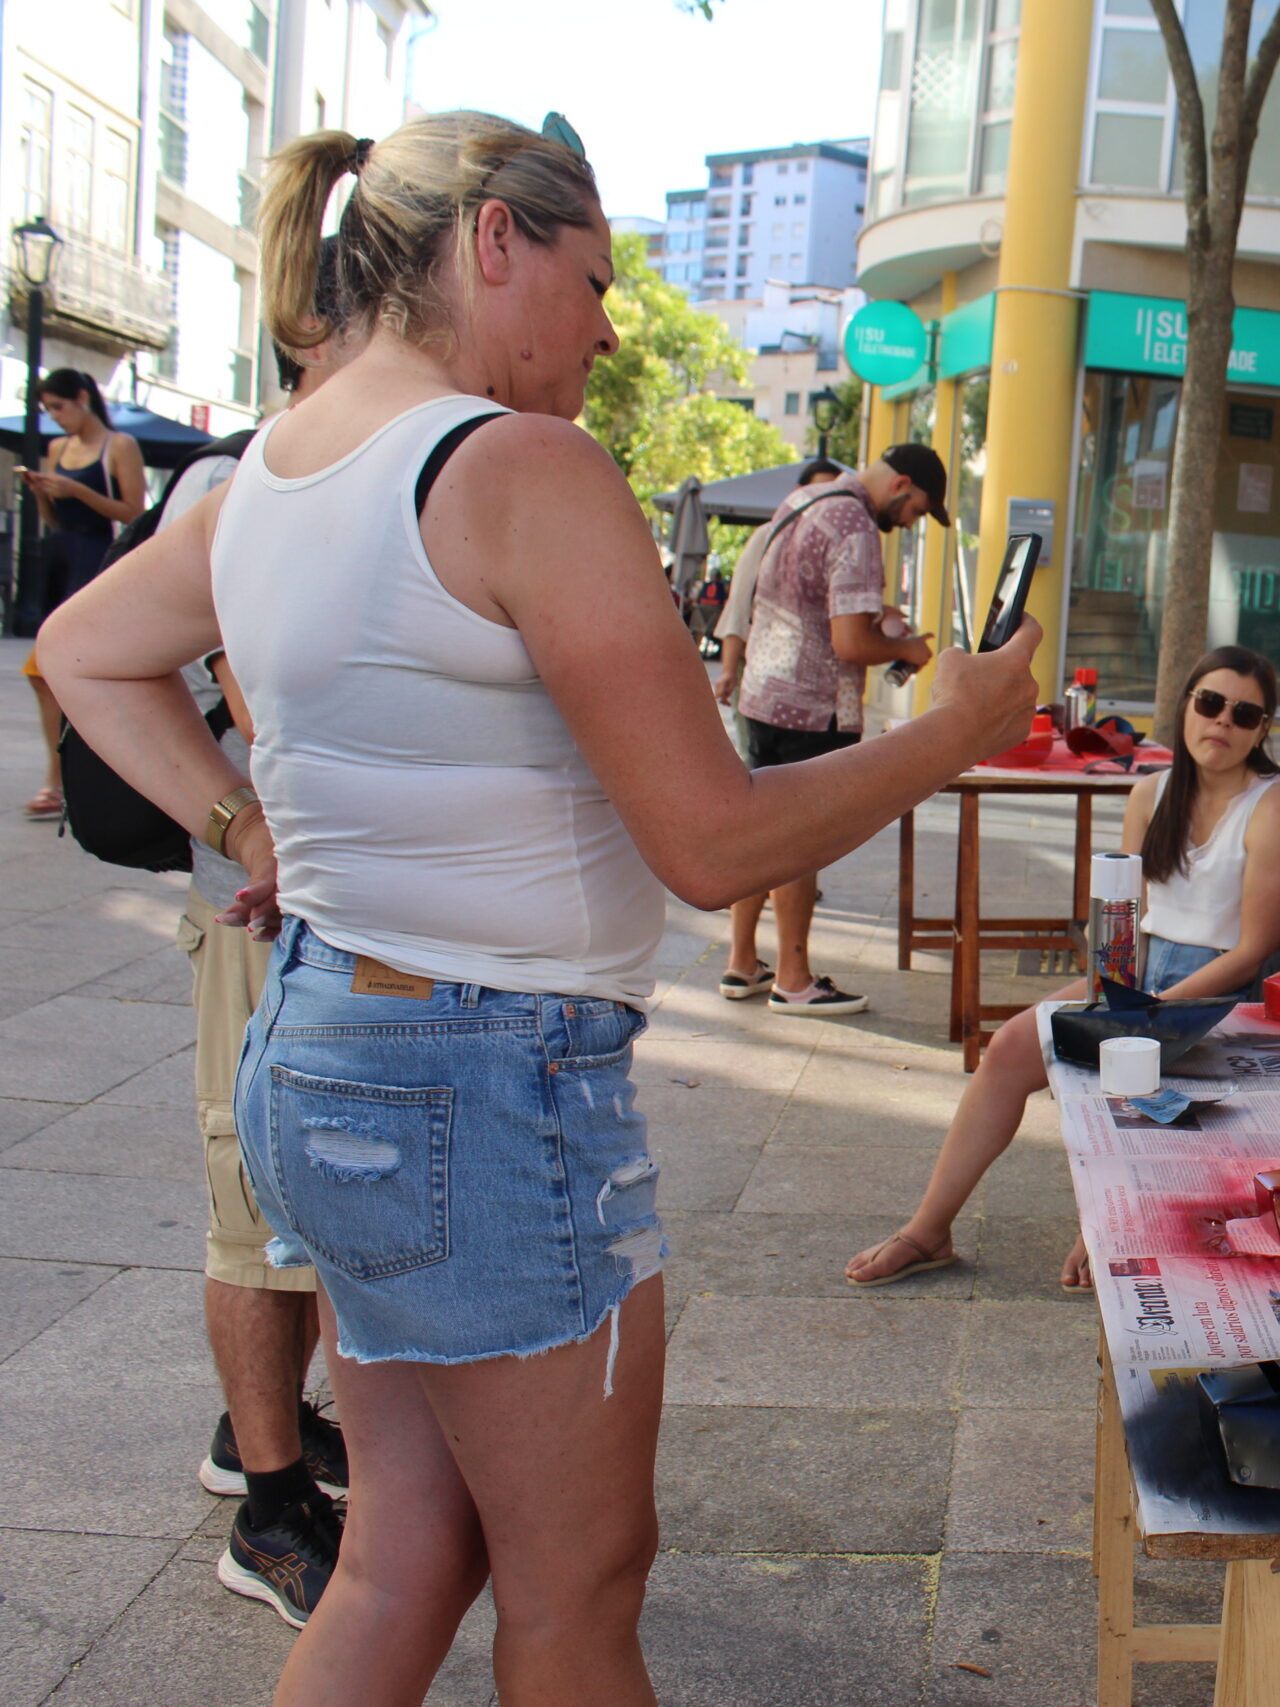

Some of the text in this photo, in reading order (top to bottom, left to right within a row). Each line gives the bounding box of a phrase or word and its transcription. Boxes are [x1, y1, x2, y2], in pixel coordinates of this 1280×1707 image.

[1215, 1287, 1237, 1312] dignos
[1192, 1301, 1226, 1358] Jovens em luta
[1224, 1313, 1249, 1343] salários
[1236, 1344, 1260, 1359] por
